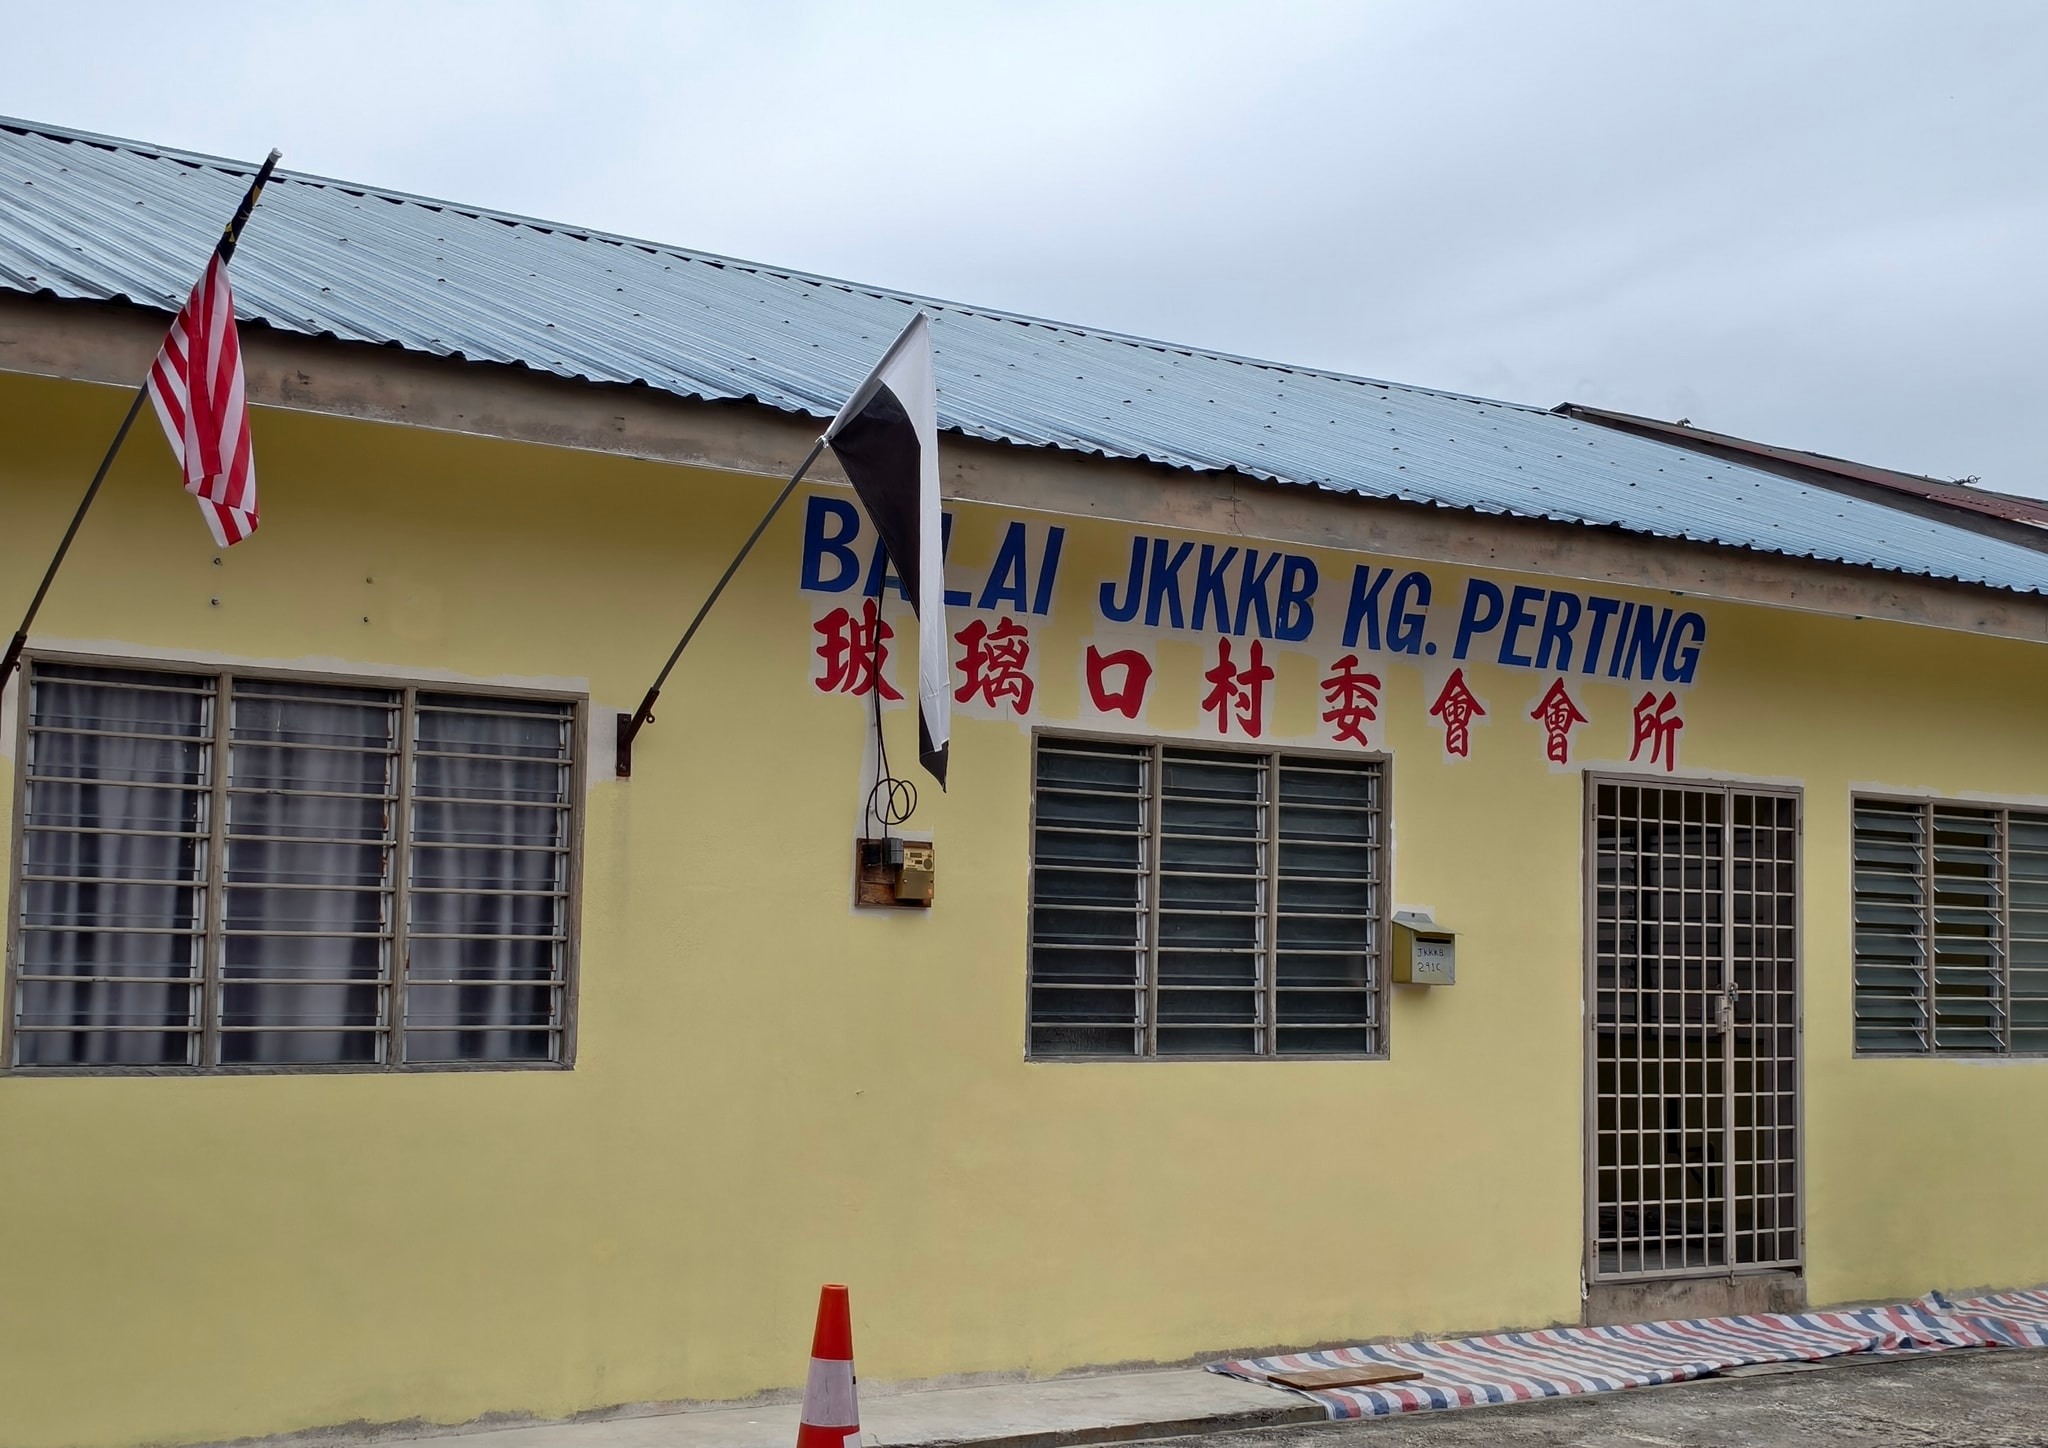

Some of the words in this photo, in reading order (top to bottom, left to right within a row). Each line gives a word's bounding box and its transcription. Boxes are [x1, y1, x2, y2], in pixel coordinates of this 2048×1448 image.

[1100, 536, 1319, 641] JKKKB
[1342, 564, 1437, 656] KG.
[1452, 578, 1706, 683] PERTING
